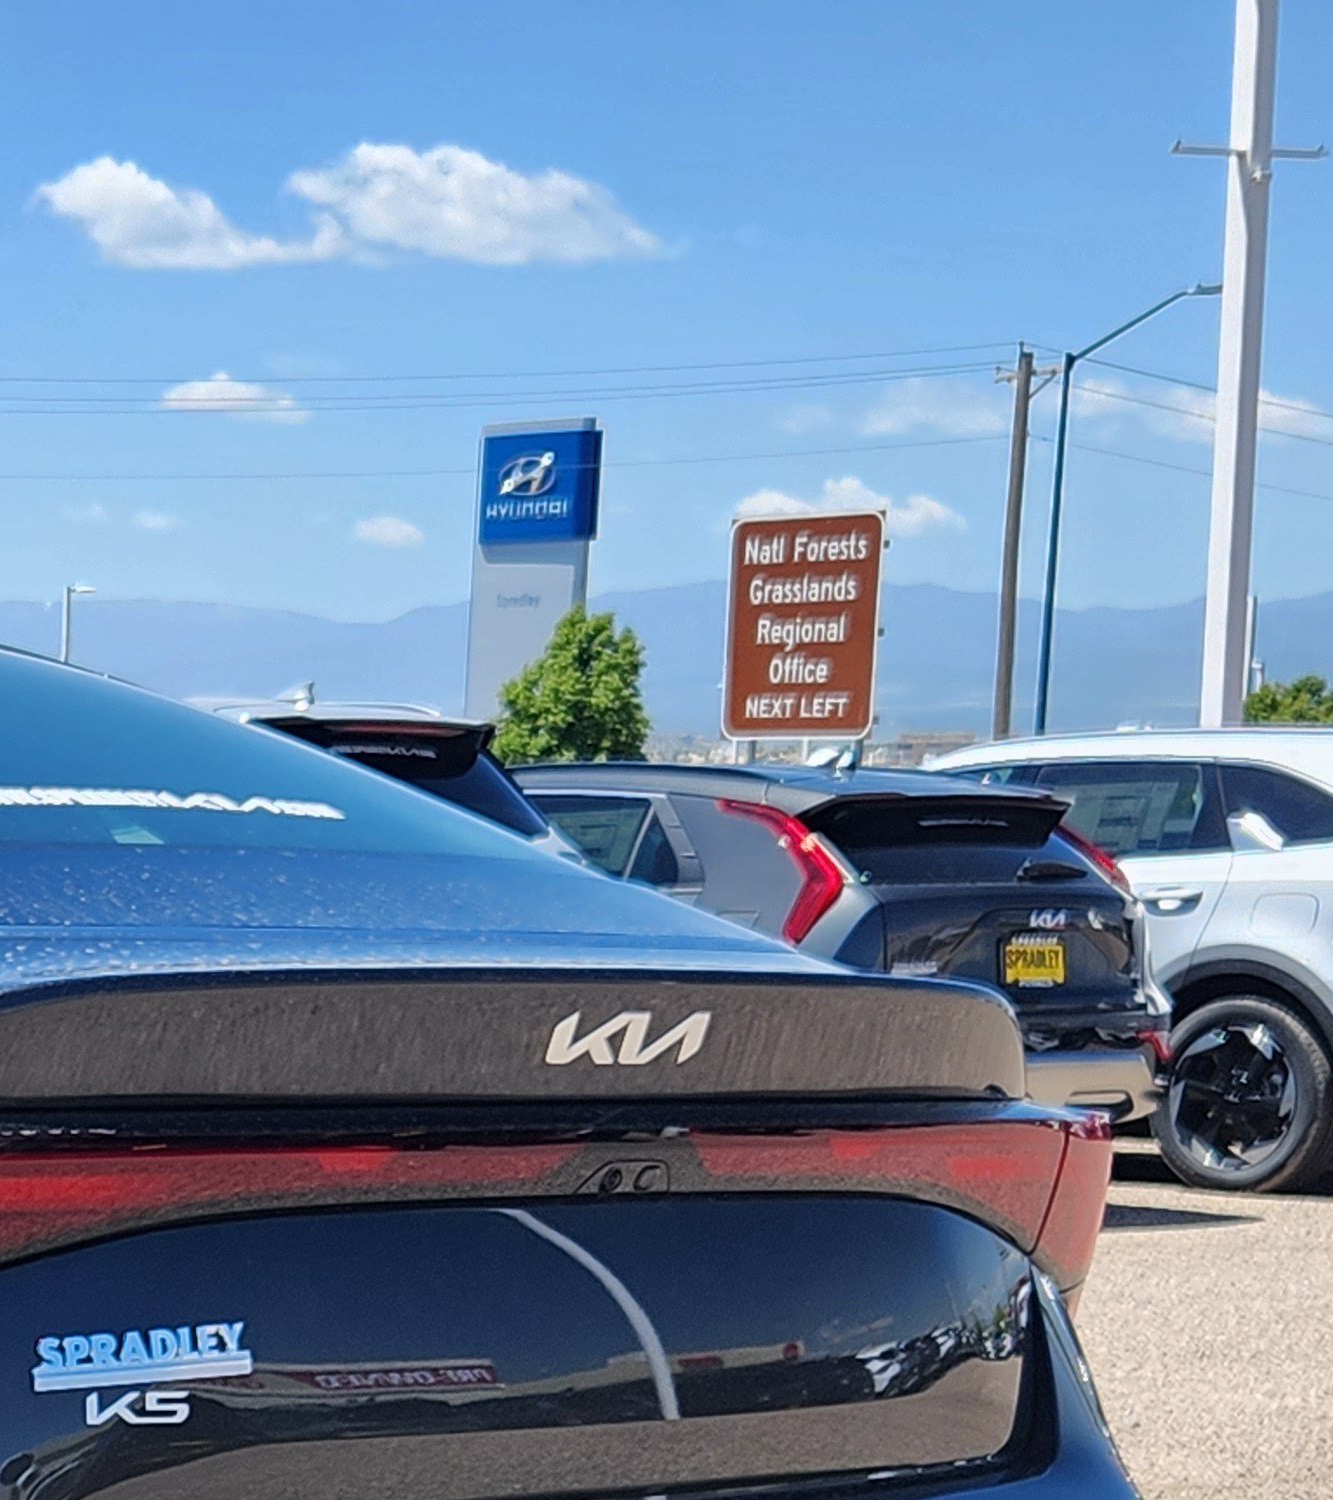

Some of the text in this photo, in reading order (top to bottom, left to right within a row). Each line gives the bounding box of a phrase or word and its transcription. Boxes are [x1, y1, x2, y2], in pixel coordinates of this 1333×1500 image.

[486, 499, 568, 519] HYUNDAI
[744, 532, 869, 565] Natl Forests
[749, 573, 858, 605] Grasslands
[756, 615, 846, 651] Regional
[769, 656, 829, 684] Office
[745, 696, 849, 718] NEXT LEFT
[1029, 909, 1067, 928] KIA
[545, 1011, 711, 1065] KIA
[36, 1321, 244, 1369] SPRADLEY
[85, 1391, 191, 1425] K5
